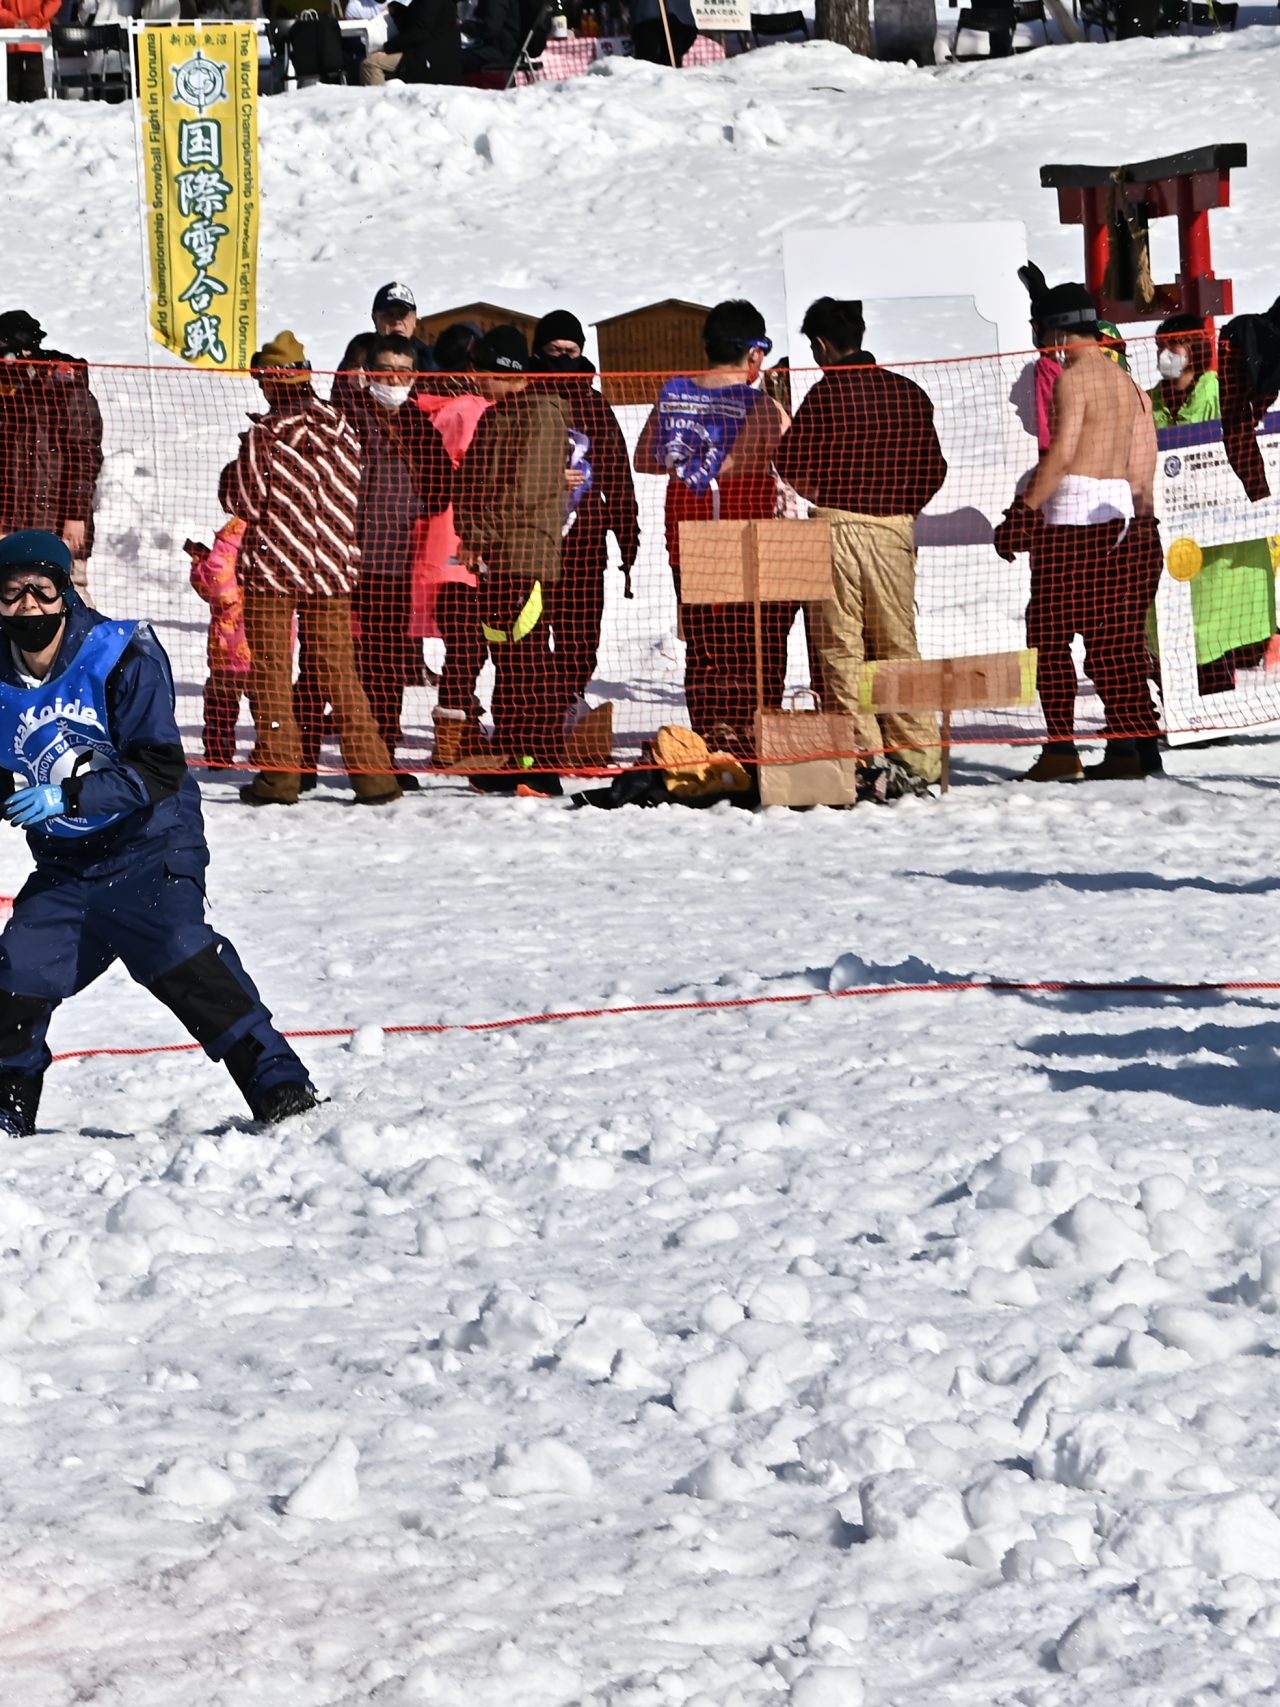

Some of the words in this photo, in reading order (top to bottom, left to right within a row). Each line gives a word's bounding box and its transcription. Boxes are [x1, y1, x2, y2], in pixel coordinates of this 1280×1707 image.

[147, 33, 158, 88] Uonuma
[240, 31, 251, 57] The
[148, 92, 158, 106] in
[240, 59, 252, 100] World
[149, 106, 161, 143] Fight
[241, 103, 255, 198] Championship
[150, 149, 164, 209] Snowball
[175, 117, 234, 364] 国際雪合戦
[240, 202, 254, 260] Snowball
[156, 213, 169, 307] Championship
[239, 263, 251, 295] Fight
[238, 316, 250, 370] Uonuma
[39, 752, 56, 782] SNOW
[55, 736, 83, 754] BALL
